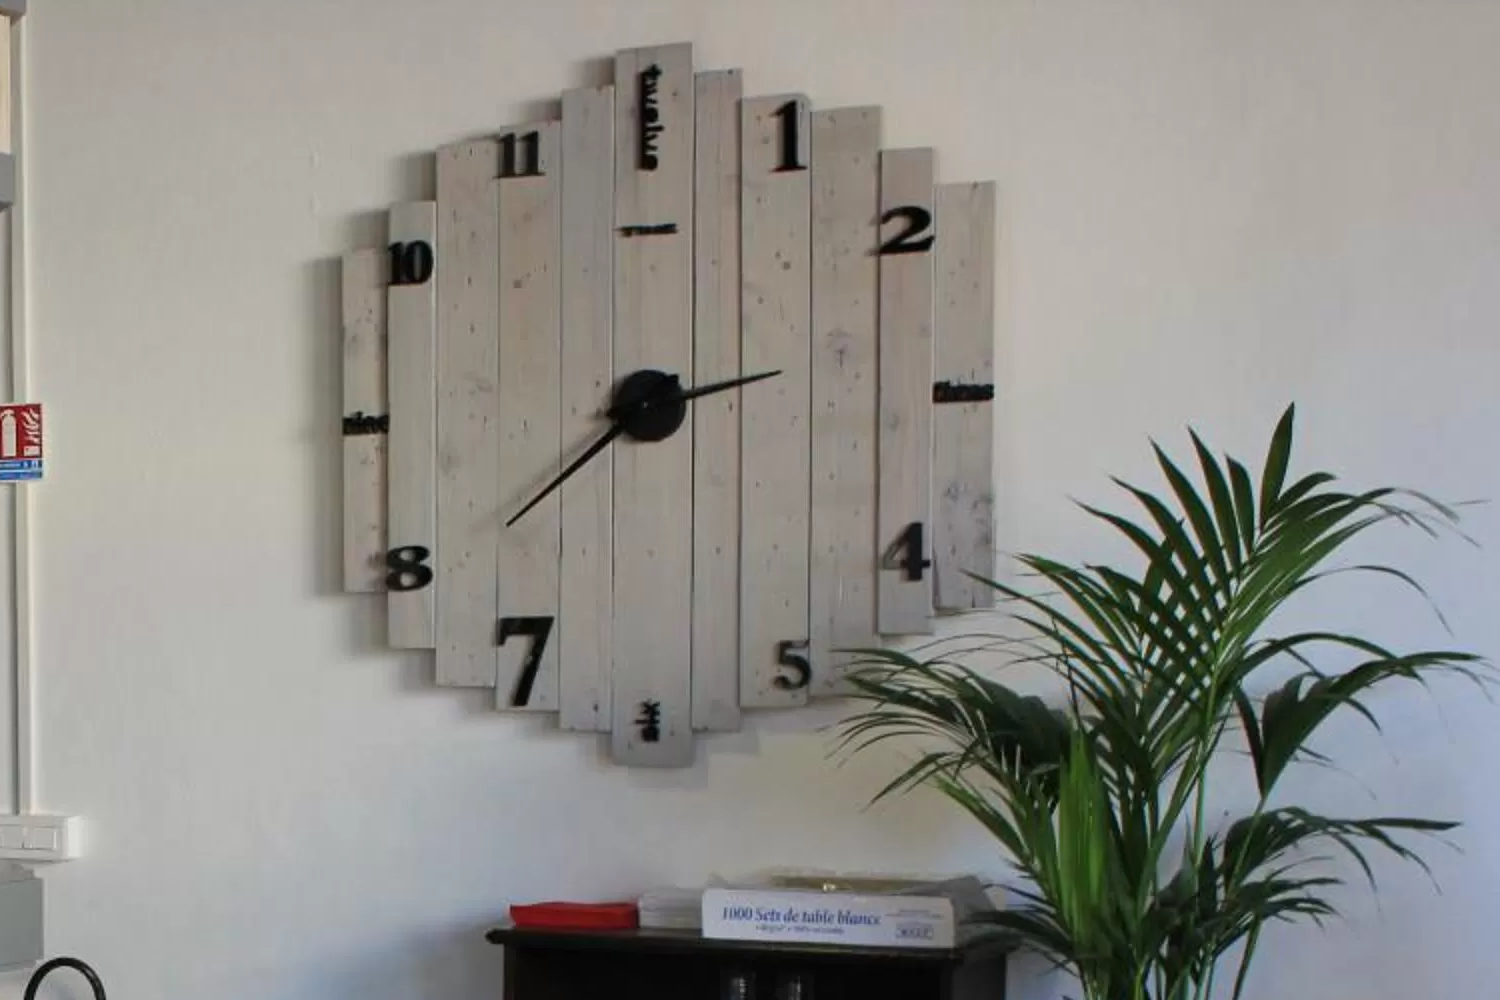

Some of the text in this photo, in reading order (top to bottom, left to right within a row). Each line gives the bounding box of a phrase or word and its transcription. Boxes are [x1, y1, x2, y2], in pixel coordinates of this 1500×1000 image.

[494, 130, 546, 179] 11
[768, 100, 807, 172] 1
[876, 205, 935, 256] 2
[387, 239, 434, 287] 10
[385, 545, 434, 592] 8
[880, 520, 931, 582] 4
[493, 615, 555, 707] 7
[774, 639, 811, 690] 5
[722, 906, 752, 921] 1000
[784, 907, 799, 923] de
[802, 910, 834, 925] table
